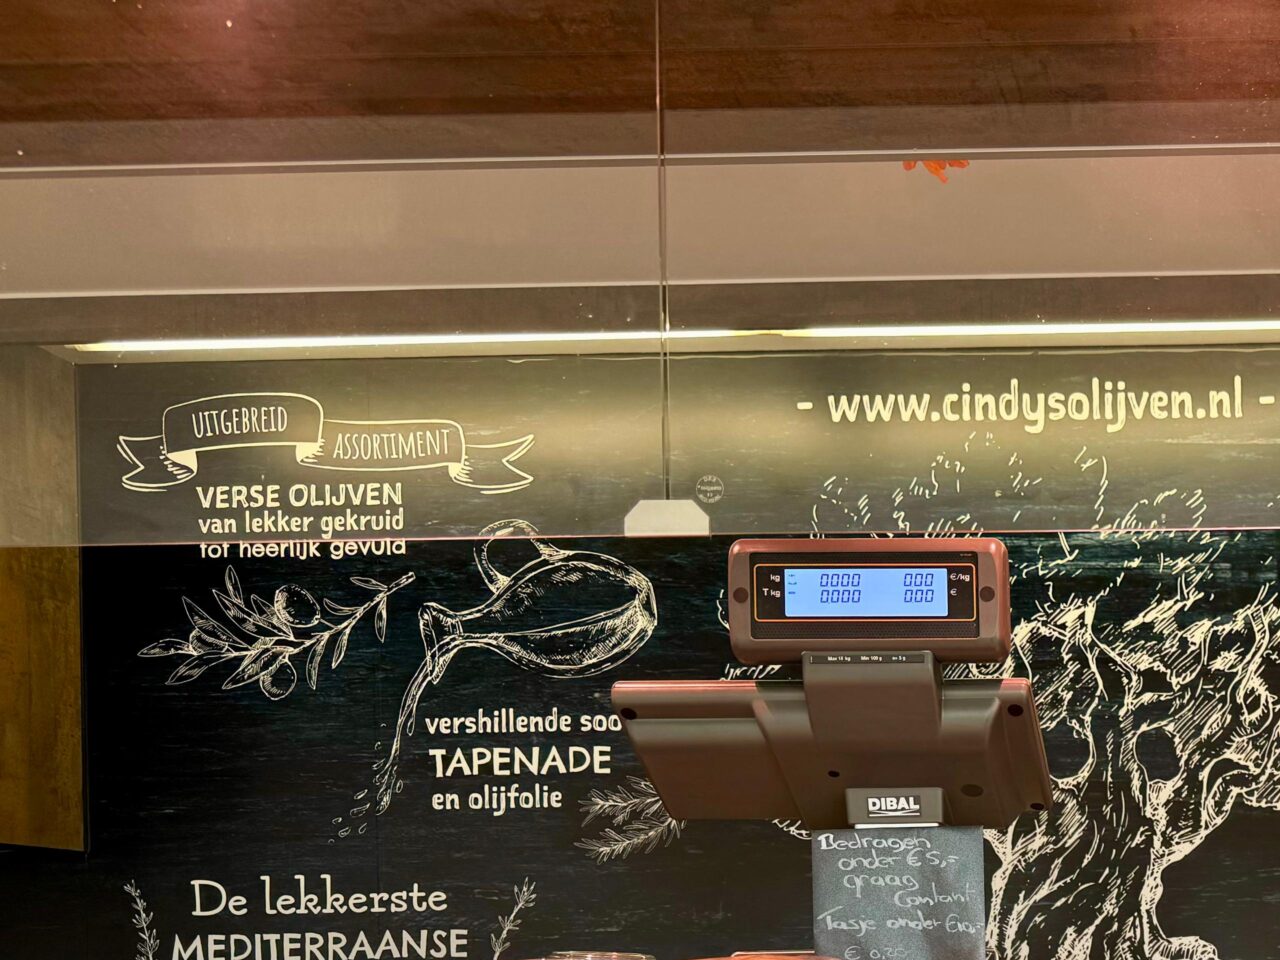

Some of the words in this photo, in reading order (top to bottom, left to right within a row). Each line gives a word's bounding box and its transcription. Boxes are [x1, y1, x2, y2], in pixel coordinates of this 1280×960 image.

[827, 375, 1244, 434] www.cindysolijven.nl
[192, 406, 289, 440] UITGEBREID
[332, 429, 450, 462] ASSORTIMENT
[197, 485, 280, 510] VERSE
[289, 481, 404, 508] OLIJVEN
[199, 514, 239, 534] van
[245, 509, 315, 534] lekker
[321, 507, 405, 539] gekruid
[238, 537, 323, 561] heerlijk
[331, 536, 407, 560] gevuld
[770, 573, 781, 583] kg
[950, 572, 971, 583] €/kg
[762, 588, 769, 597] T
[771, 588, 781, 598] kg
[425, 708, 573, 736] vershillende
[428, 746, 612, 778] TAPENADE
[432, 790, 460, 811] en
[468, 786, 563, 817] olijfolie
[867, 796, 920, 811] DIBAL
[817, 833, 932, 853] Bedragen
[838, 849, 901, 871] onder
[190, 878, 247, 918] De
[260, 874, 448, 917] lekkerste
[843, 874, 919, 899] graag
